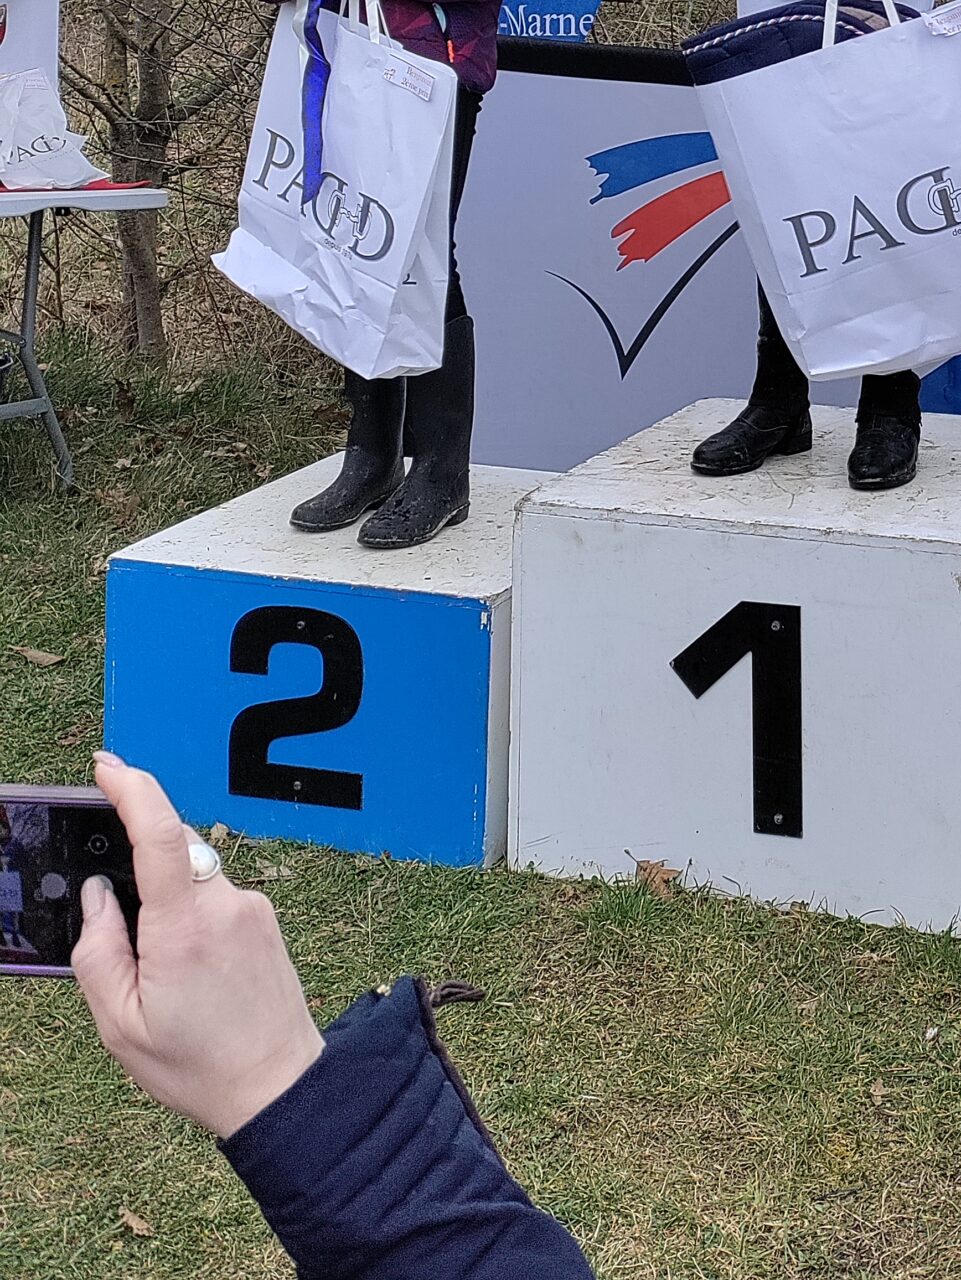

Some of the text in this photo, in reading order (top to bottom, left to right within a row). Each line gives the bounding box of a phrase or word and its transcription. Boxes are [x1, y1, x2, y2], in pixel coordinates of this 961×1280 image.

[499, 4, 594, 38] -Marne
[229, 605, 364, 811] 2
[670, 601, 803, 839] 1
